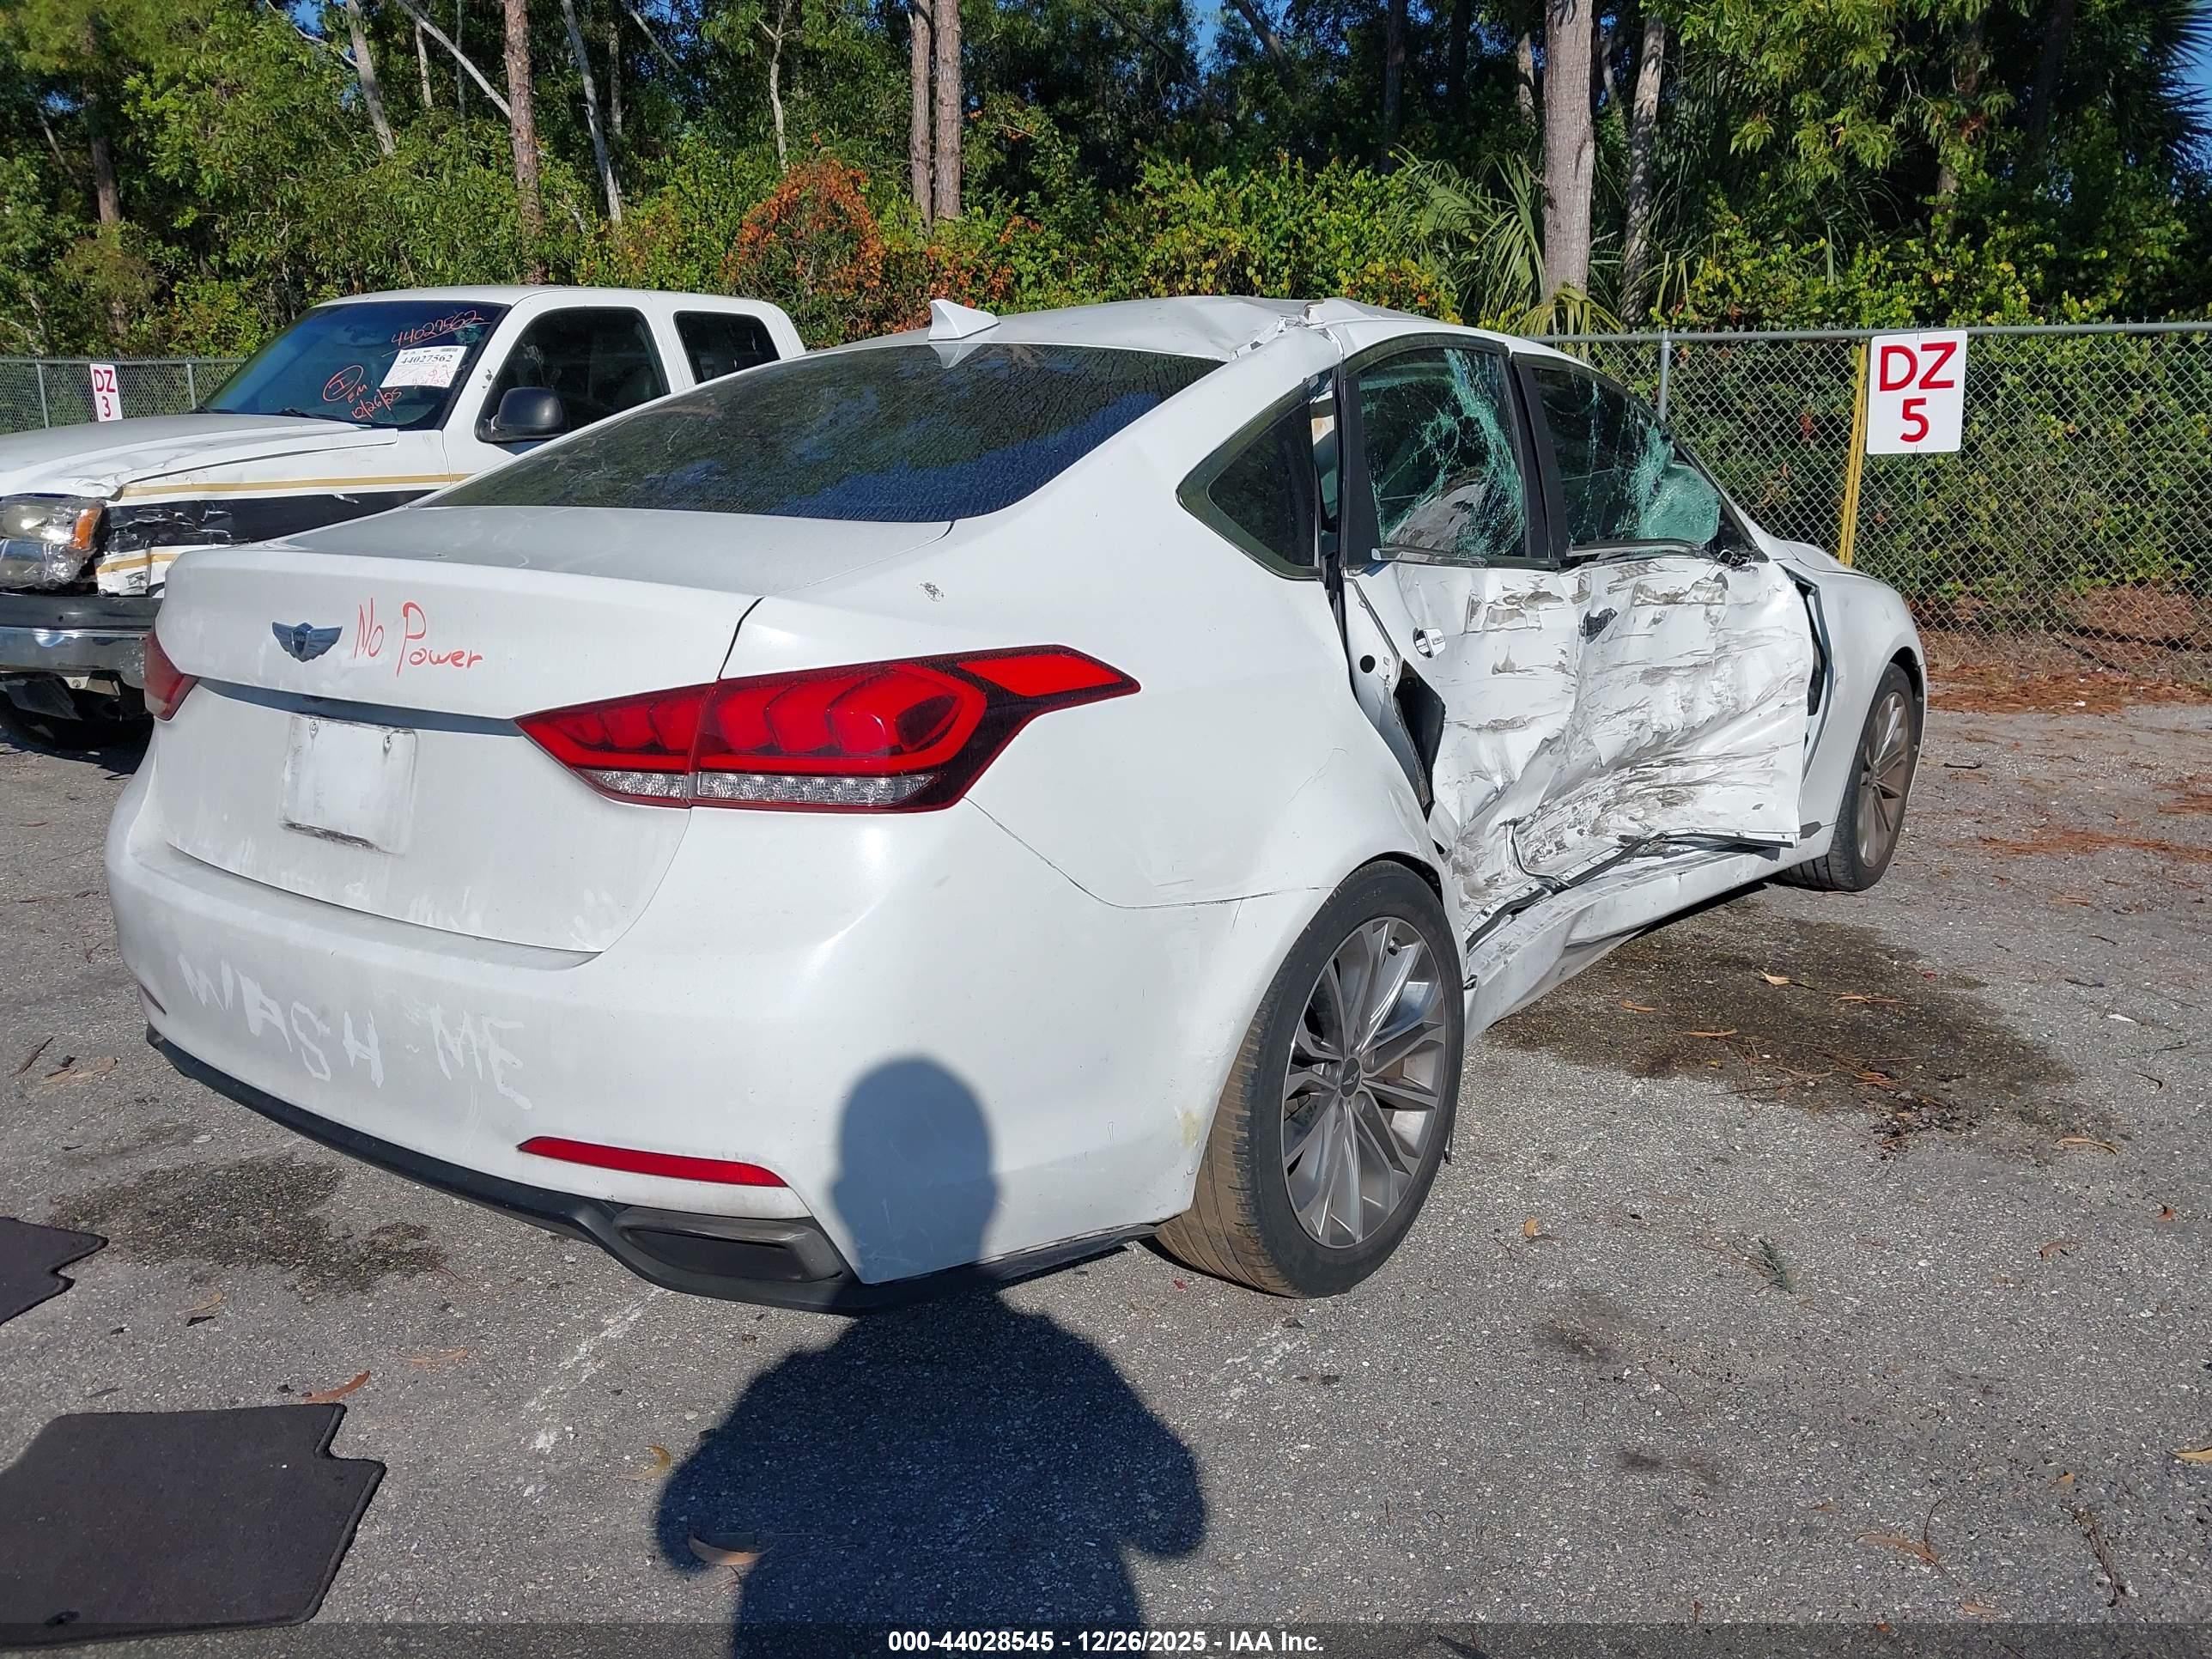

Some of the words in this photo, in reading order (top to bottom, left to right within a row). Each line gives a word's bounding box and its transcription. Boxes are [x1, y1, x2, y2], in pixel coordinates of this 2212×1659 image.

[391, 310, 483, 346] 44027562
[400, 354, 453, 364] 44027562
[1880, 341, 1957, 392] DZ
[93, 368, 117, 393] DZ
[101, 395, 111, 418] 3
[351, 388, 403, 420] 12/26/25
[1899, 398, 1929, 442] 5
[354, 598, 384, 658] No
[397, 601, 483, 678] Power
[178, 954, 385, 1089] WASH
[430, 1003, 533, 1110] ME
